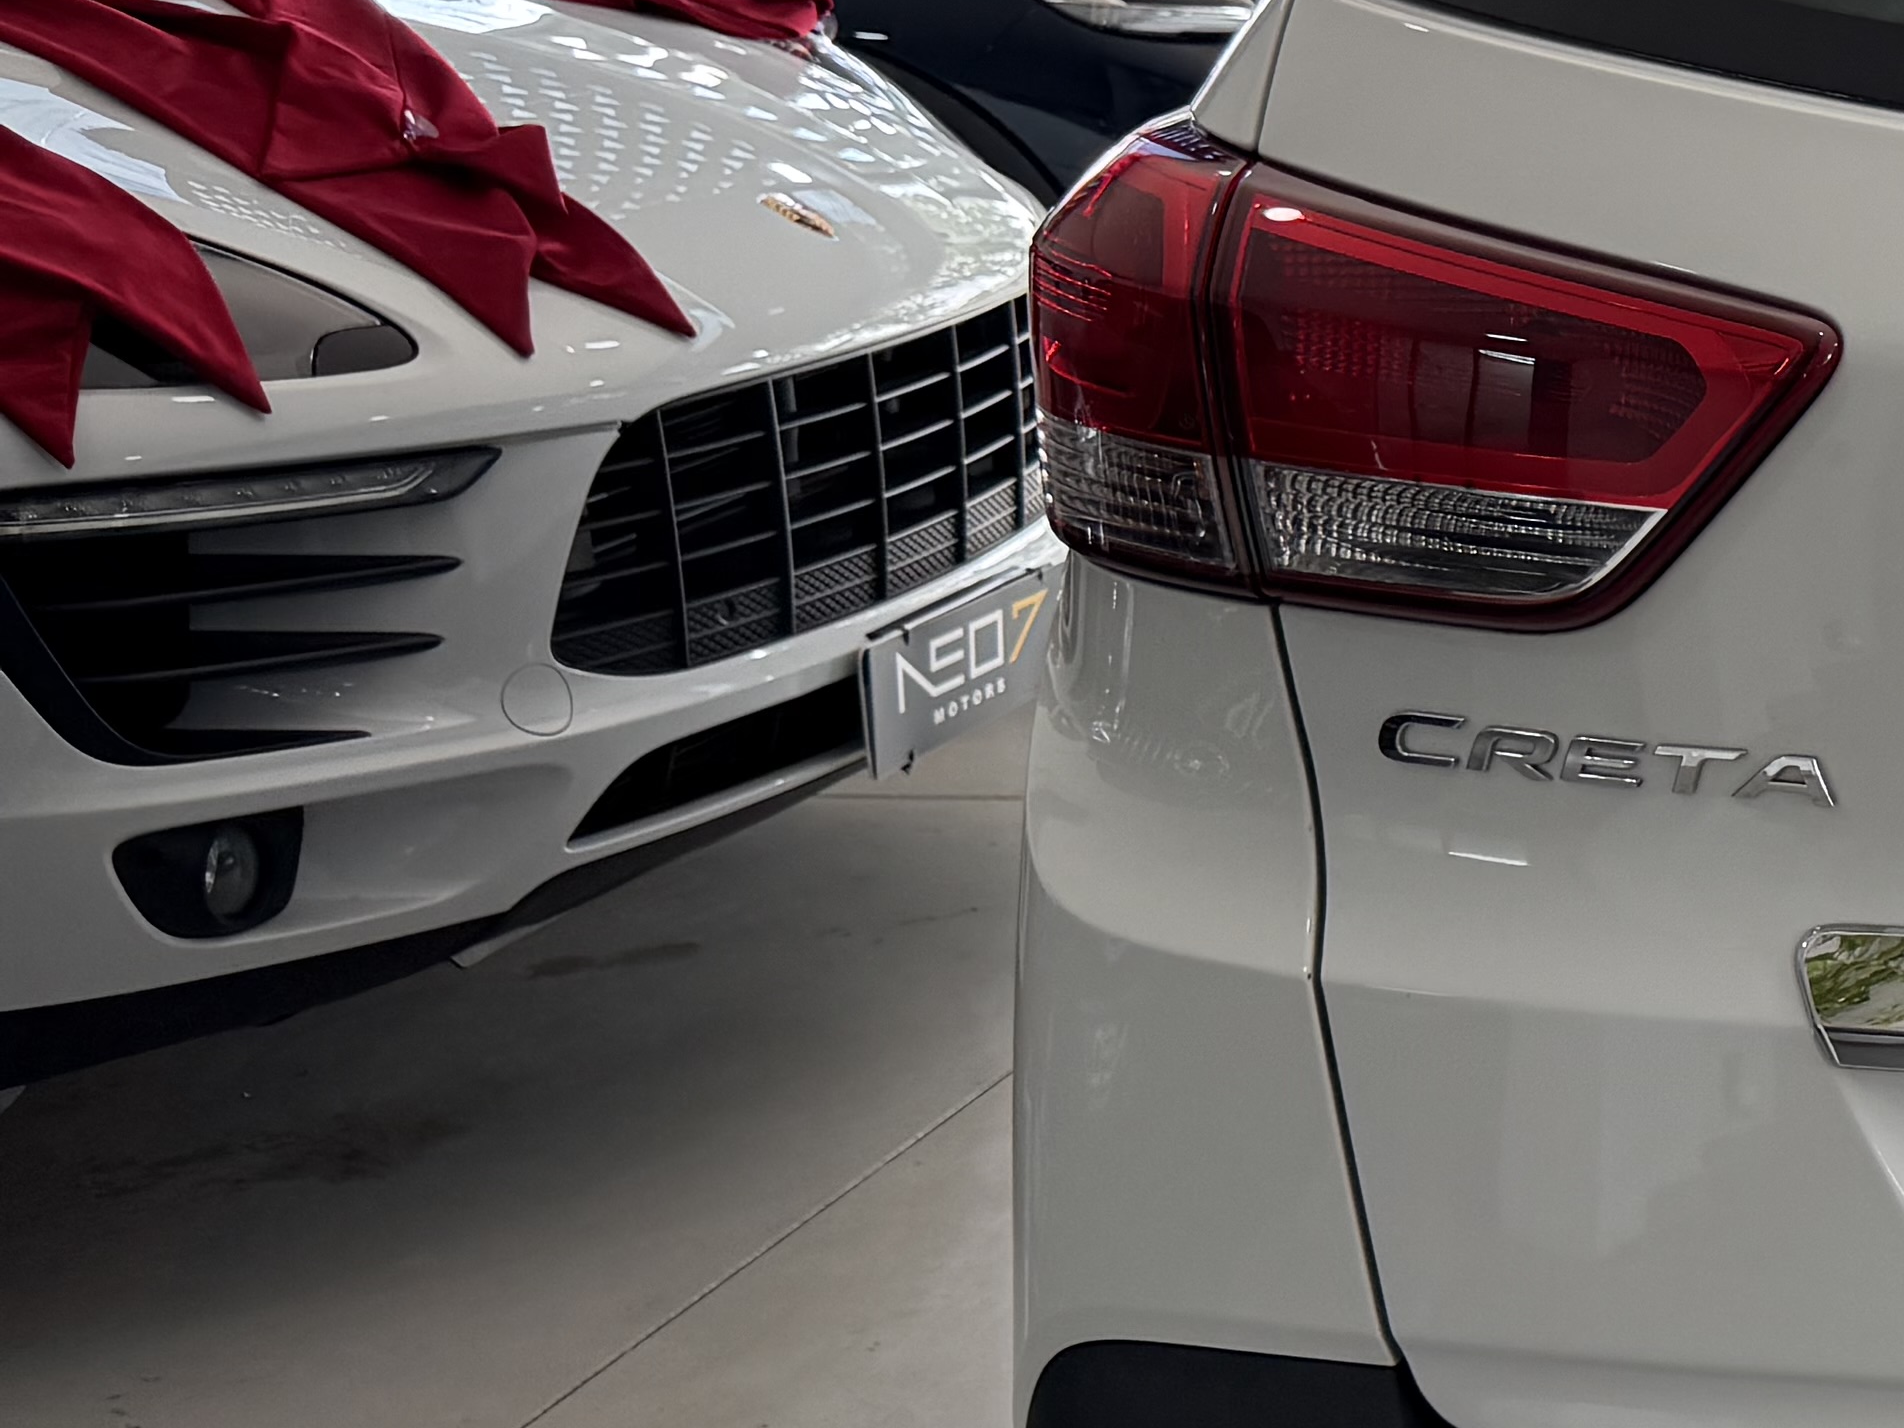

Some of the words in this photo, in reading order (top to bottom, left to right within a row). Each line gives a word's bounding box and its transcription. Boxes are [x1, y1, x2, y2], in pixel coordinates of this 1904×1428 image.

[896, 588, 1048, 713] NEO7
[934, 677, 1006, 724] MOTORS
[1377, 710, 1836, 808] CRETA
